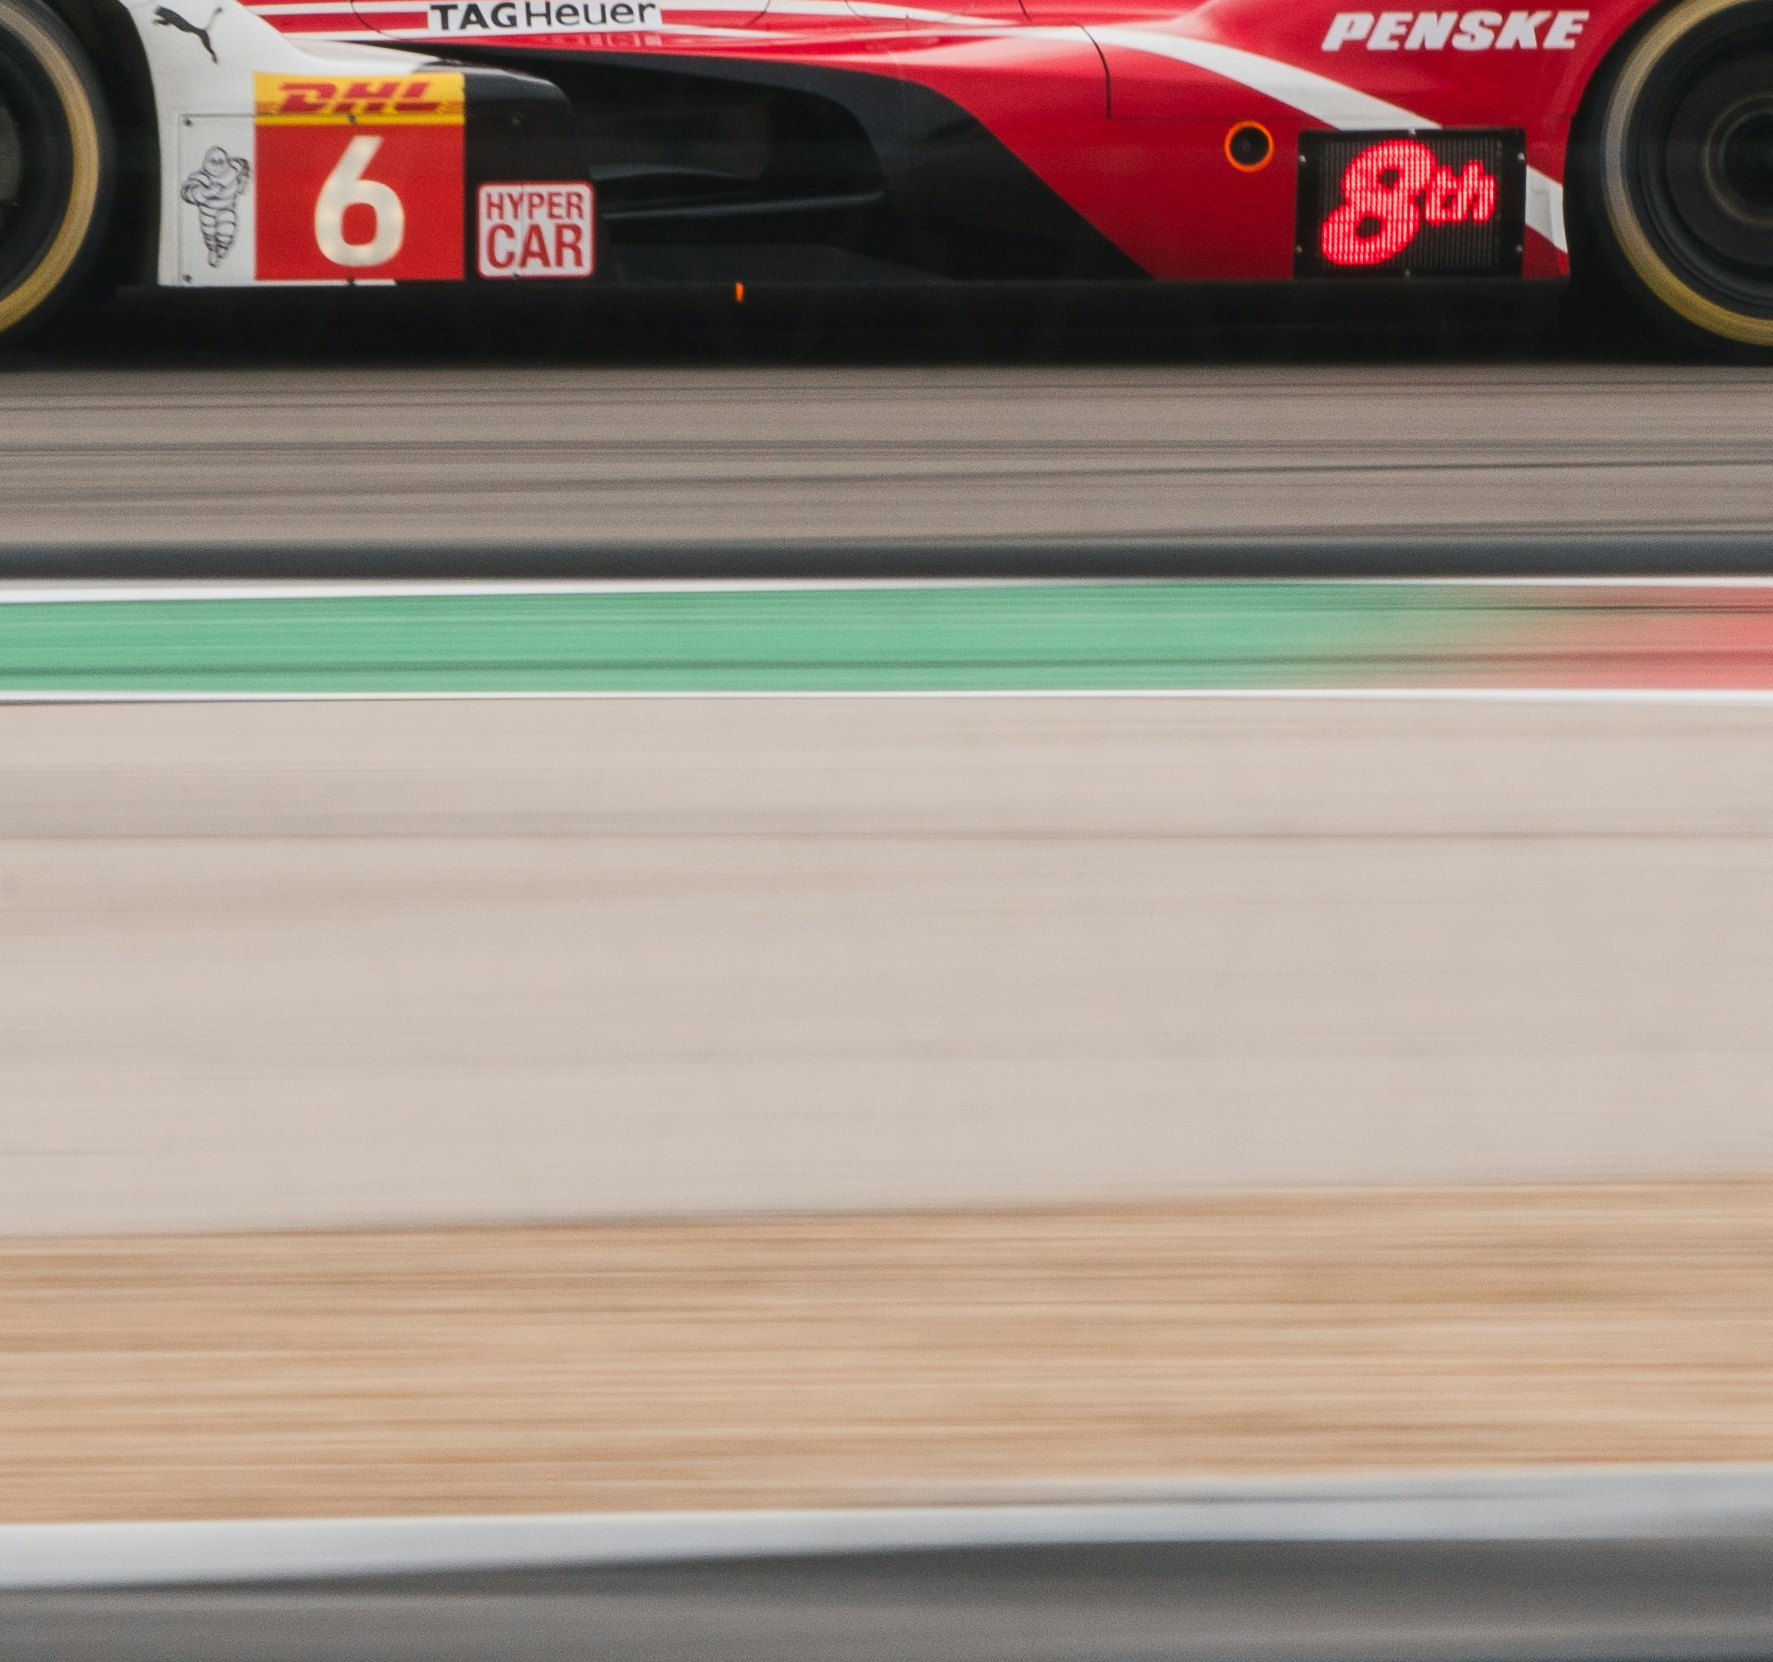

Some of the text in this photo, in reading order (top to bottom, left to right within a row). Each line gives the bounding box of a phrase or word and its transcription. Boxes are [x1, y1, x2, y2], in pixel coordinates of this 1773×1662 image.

[1321, 9, 1590, 52] PENSKE
[278, 81, 441, 114] DHL
[314, 134, 405, 268] 6
[485, 191, 585, 220] HYPER
[1320, 138, 1497, 266] 8th
[485, 222, 585, 269] CAR
